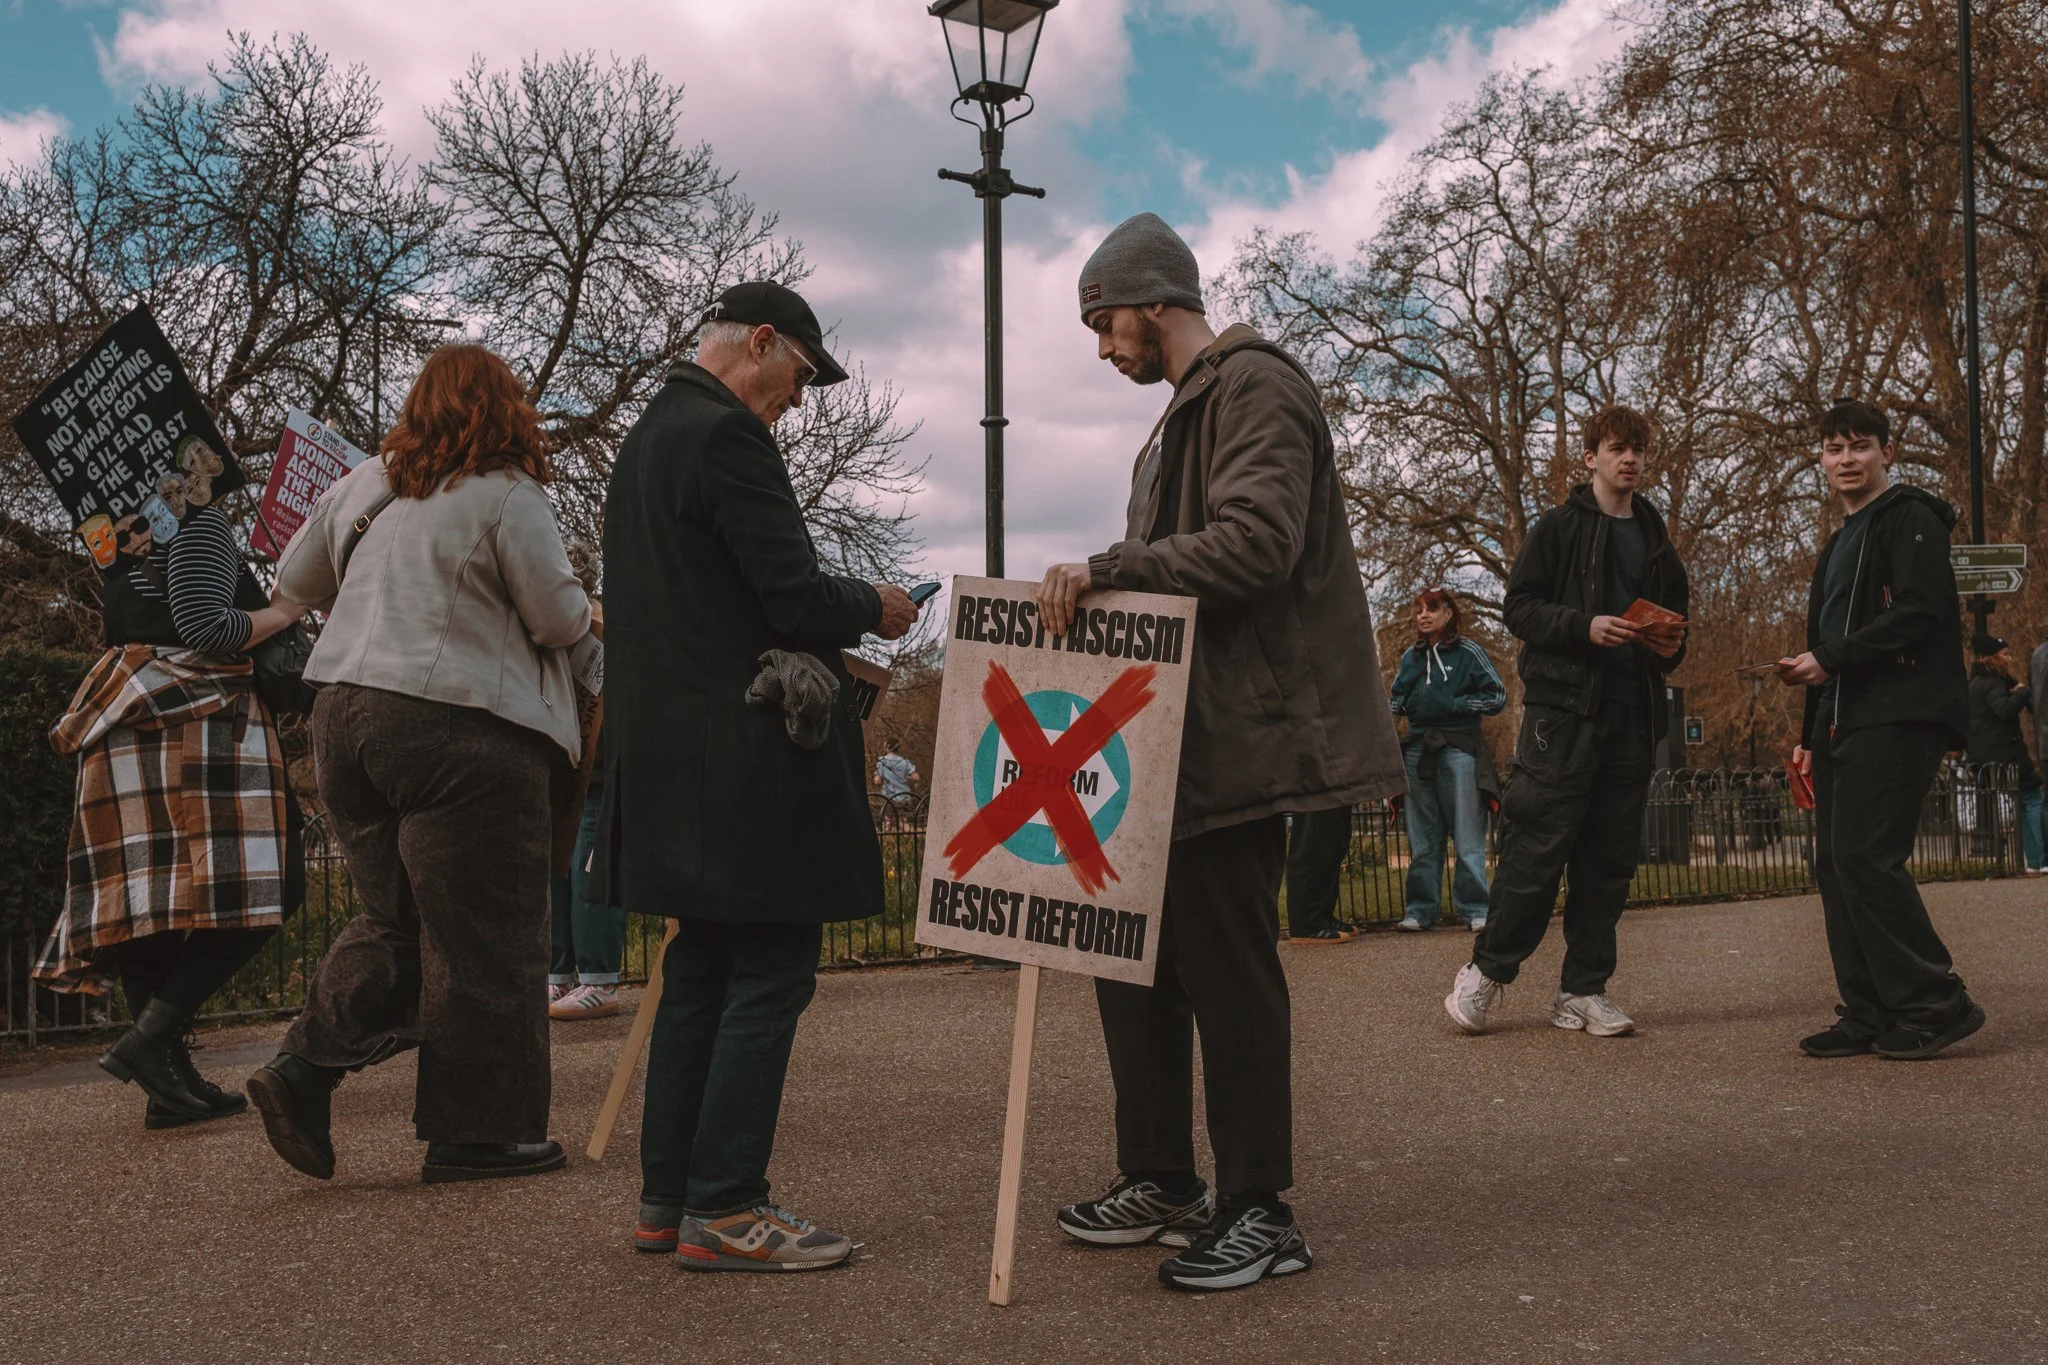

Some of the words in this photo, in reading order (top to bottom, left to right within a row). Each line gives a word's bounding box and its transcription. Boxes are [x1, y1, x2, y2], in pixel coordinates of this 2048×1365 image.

[46, 415, 83, 457] NOT
[86, 349, 153, 419] FIGHTING
[51, 457, 75, 484] IS
[72, 411, 115, 463] WHAT
[114, 382, 148, 419] GOT
[145, 364, 173, 392] US
[86, 413, 153, 481] GILEAD
[294, 436, 343, 480] WOMEN
[322, 438, 330, 448] TO
[329, 444, 348, 461] RACISM
[323, 430, 340, 447] STAND
[340, 442, 348, 452] UP
[76, 492, 98, 521] IN
[97, 460, 134, 498] THE
[138, 411, 188, 464] FIRST
[284, 468, 312, 499] THE
[276, 485, 313, 519] RIGH
[276, 507, 300, 527] Reject
[928, 878, 1025, 939] RESIST
[1025, 895, 1148, 962] REFORM
